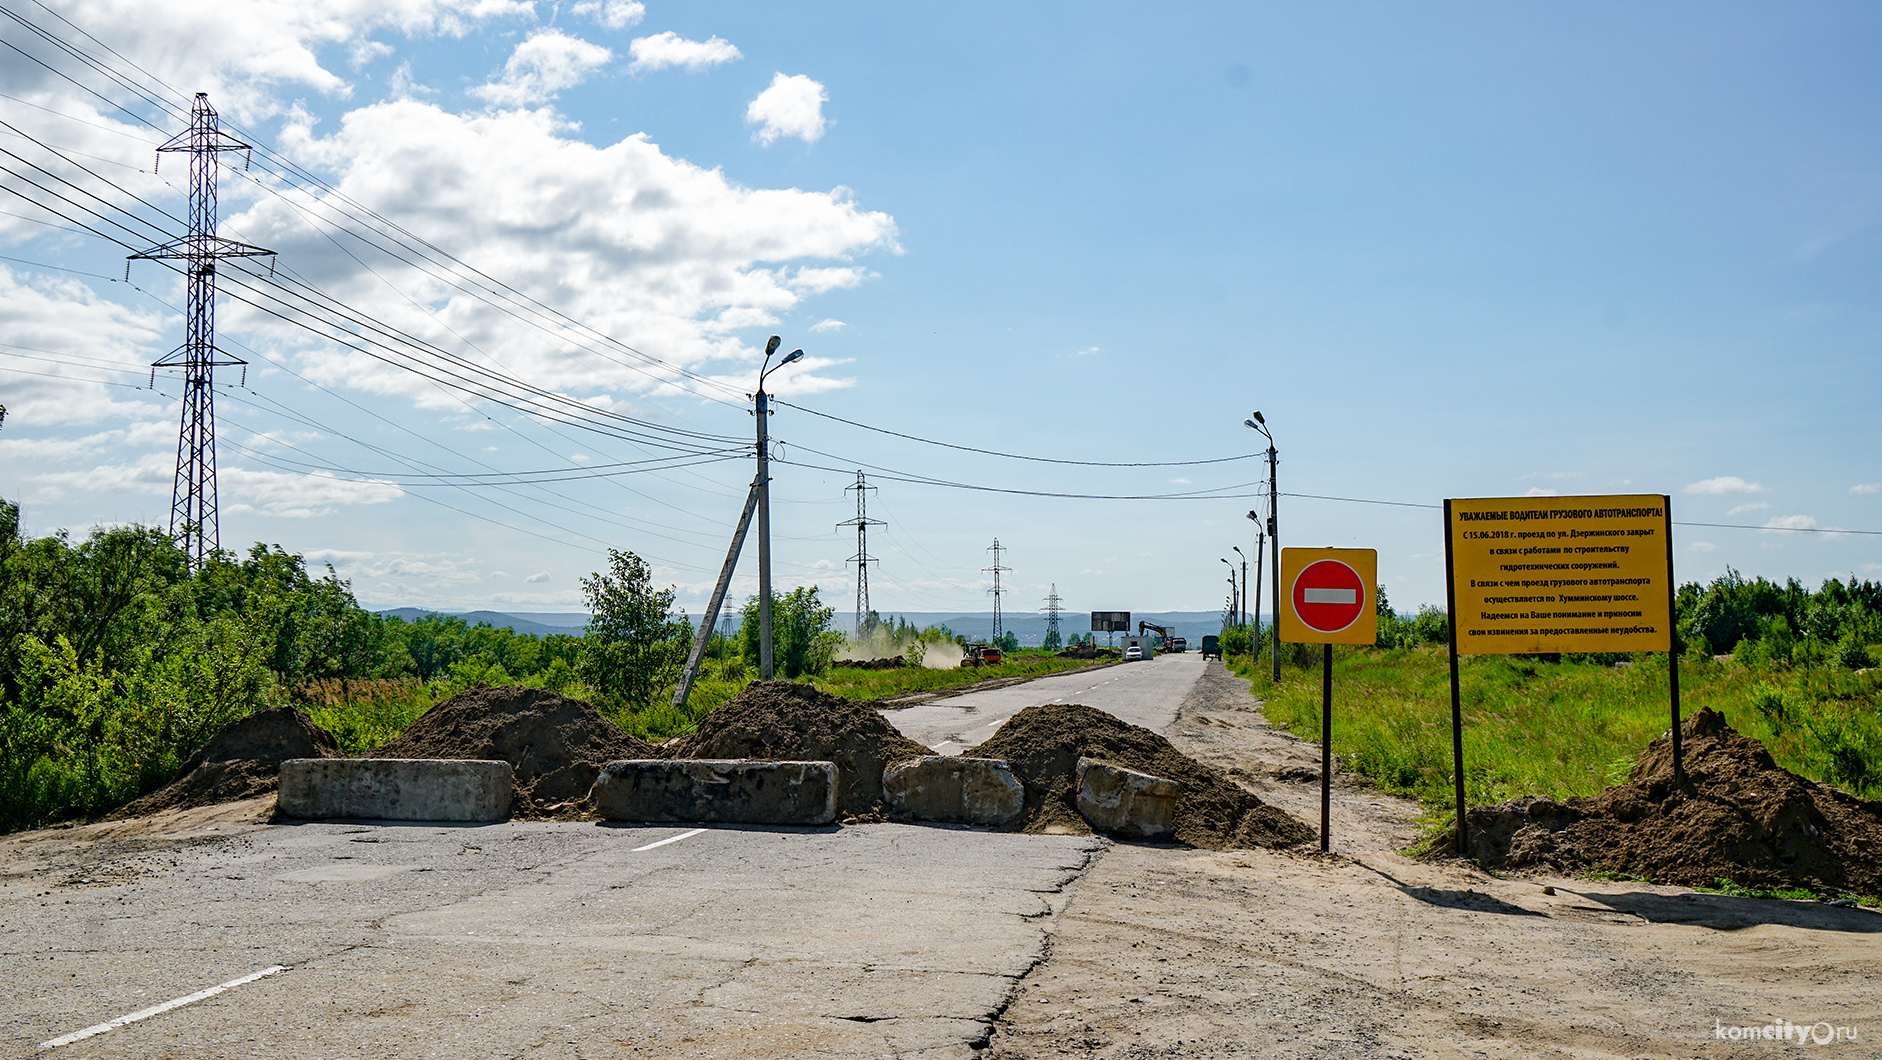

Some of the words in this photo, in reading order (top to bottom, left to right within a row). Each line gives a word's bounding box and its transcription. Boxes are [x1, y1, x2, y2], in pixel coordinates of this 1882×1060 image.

[1459, 511, 1508, 521] УВАЖАЕМЫЕ
[1510, 510, 1548, 521] ВОДИТЕЛИ
[1550, 510, 1592, 519] ГРУЗОВОГО
[1594, 508, 1663, 518] АВТОТРАНСПОРТА!
[1463, 531, 1468, 539] С
[1470, 531, 1509, 539] 15.06.2018
[1518, 532, 1545, 540] проезд
[1557, 531, 1569, 539] ул.
[1570, 529, 1625, 539] Дзержинского
[1626, 529, 1655, 537] закрыт
[1524, 546, 1561, 556] работами
[1574, 546, 1629, 555] строительству
[1500, 563, 1569, 572] гидротехнических
[1571, 561, 1620, 571] сооружений.
[1521, 580, 1548, 588] проезд
[1550, 579, 1587, 587] грузового
[1589, 578, 1650, 587] автотранспорта
[1484, 596, 1544, 605] осуществляется
[1559, 594, 1612, 604] Хумминскому
[1481, 612, 1518, 620] Надеемся
[1604, 610, 1642, 619] приносим
[1540, 627, 1609, 637] предоставленные
[1611, 625, 1657, 635] неудобства.
